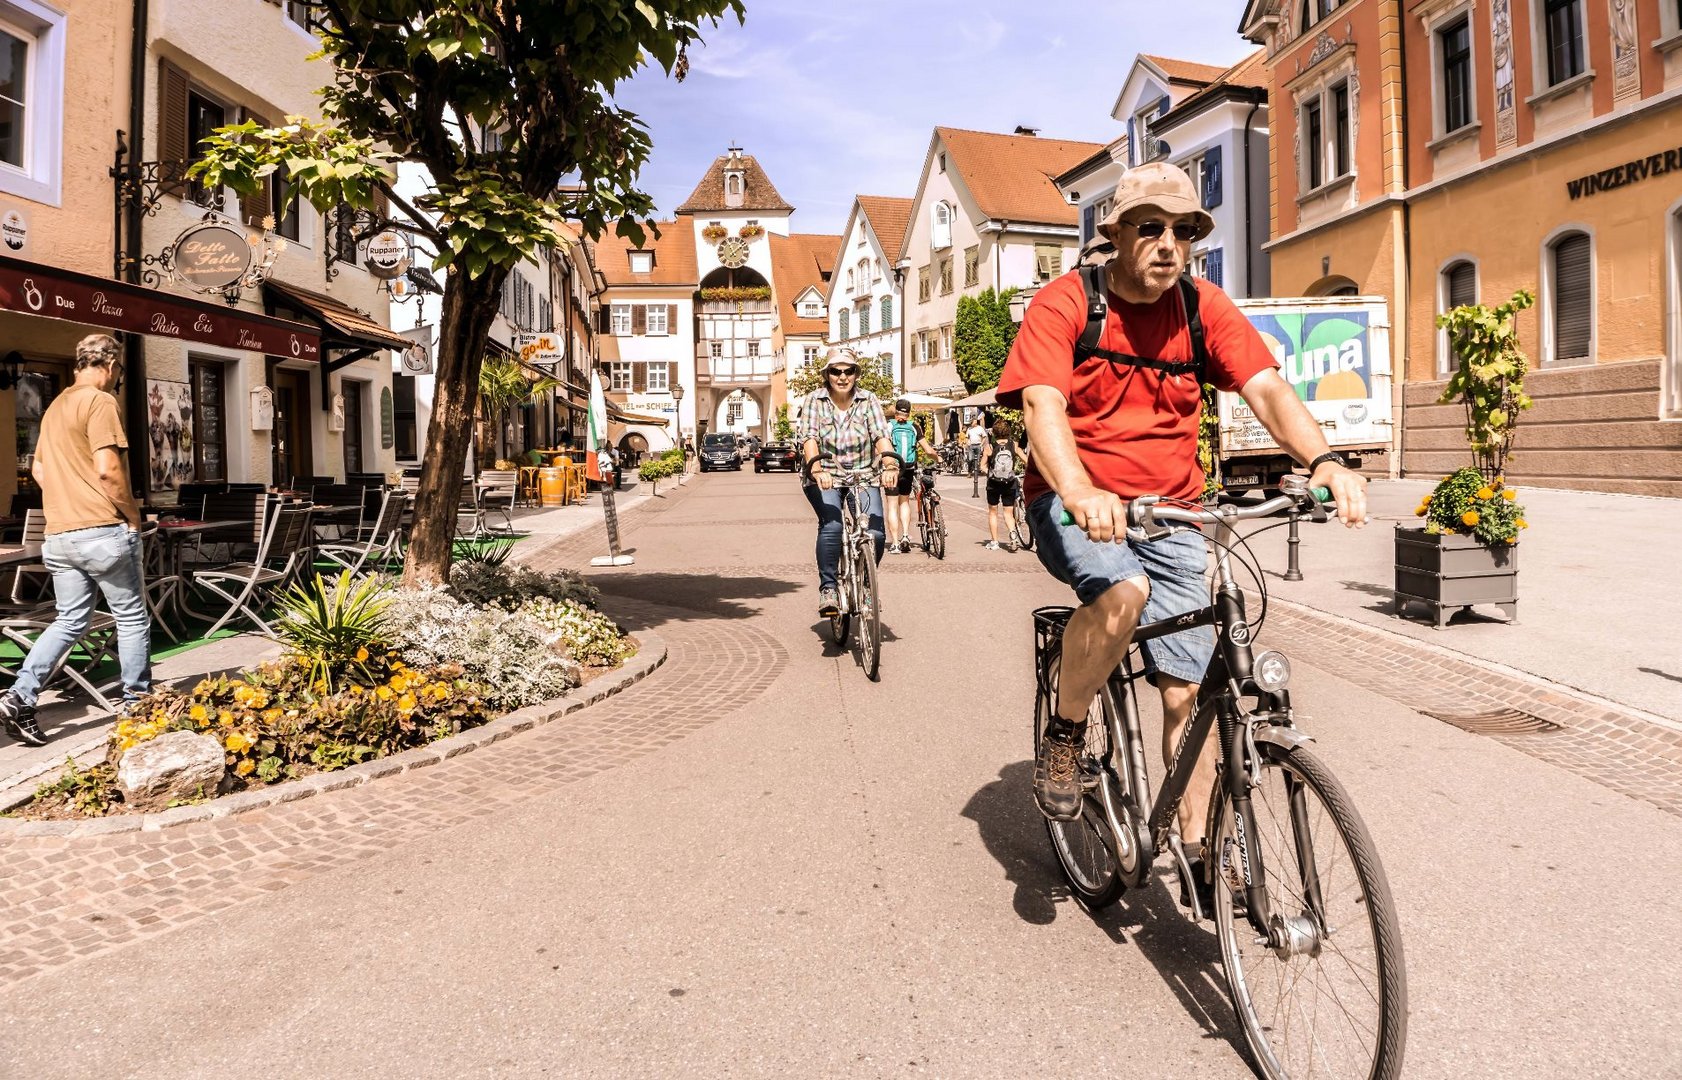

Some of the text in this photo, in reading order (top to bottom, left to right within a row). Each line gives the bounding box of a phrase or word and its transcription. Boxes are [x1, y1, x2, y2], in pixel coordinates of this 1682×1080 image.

[370, 247, 405, 255] Ruppaner
[55, 295, 75, 309] Due
[92, 291, 123, 317] Pizza
[151, 312, 179, 335] Pasta
[193, 313, 214, 333] Eis
[304, 344, 317, 353] Due
[1275, 339, 1364, 385] luna
[646, 402, 672, 411] SCHIFF
